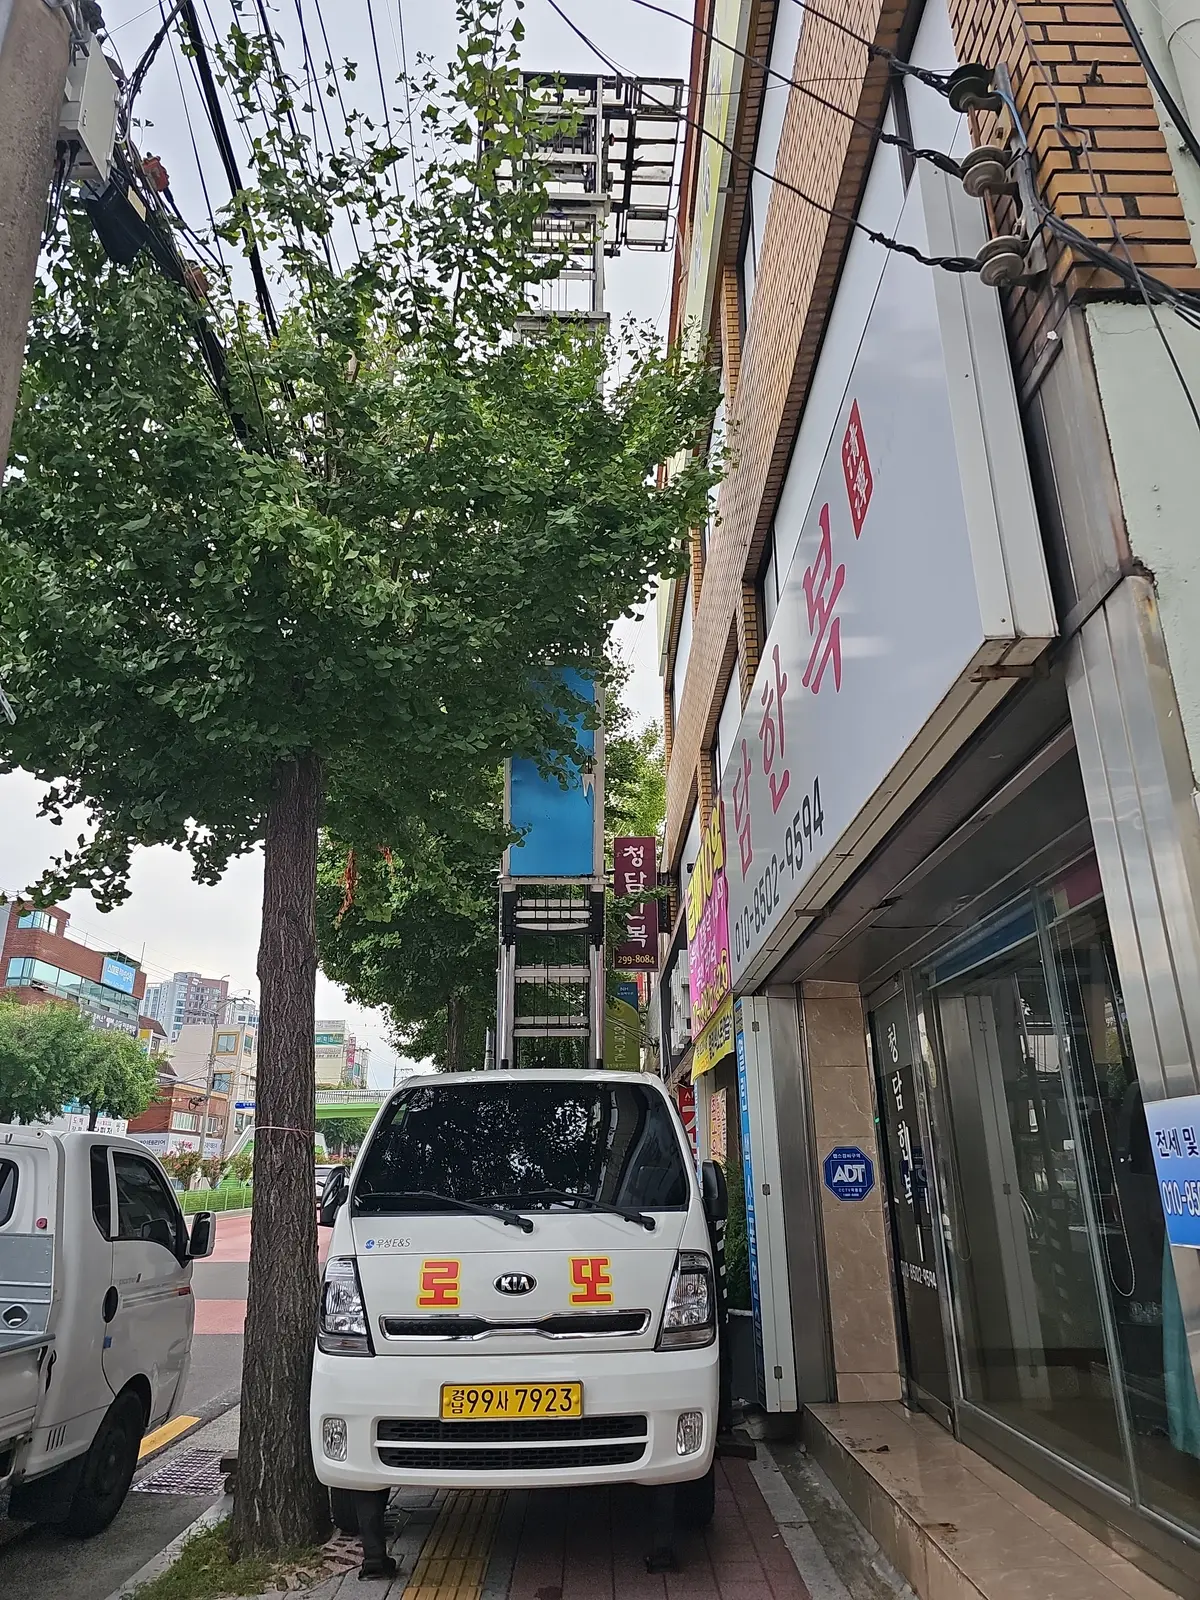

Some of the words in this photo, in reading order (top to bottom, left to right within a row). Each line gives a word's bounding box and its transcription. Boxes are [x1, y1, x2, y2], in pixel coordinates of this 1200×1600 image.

[734, 775, 825, 963] 010-8502-9594
[617, 954, 655, 965] 299-8084
[1155, 1127, 1183, 1158] 전세
[832, 1164, 866, 1183] ADT
[375, 1237, 412, 1249] 우성E&S
[500, 1275, 530, 1291] KIA
[515, 1387, 573, 1413] 7923
